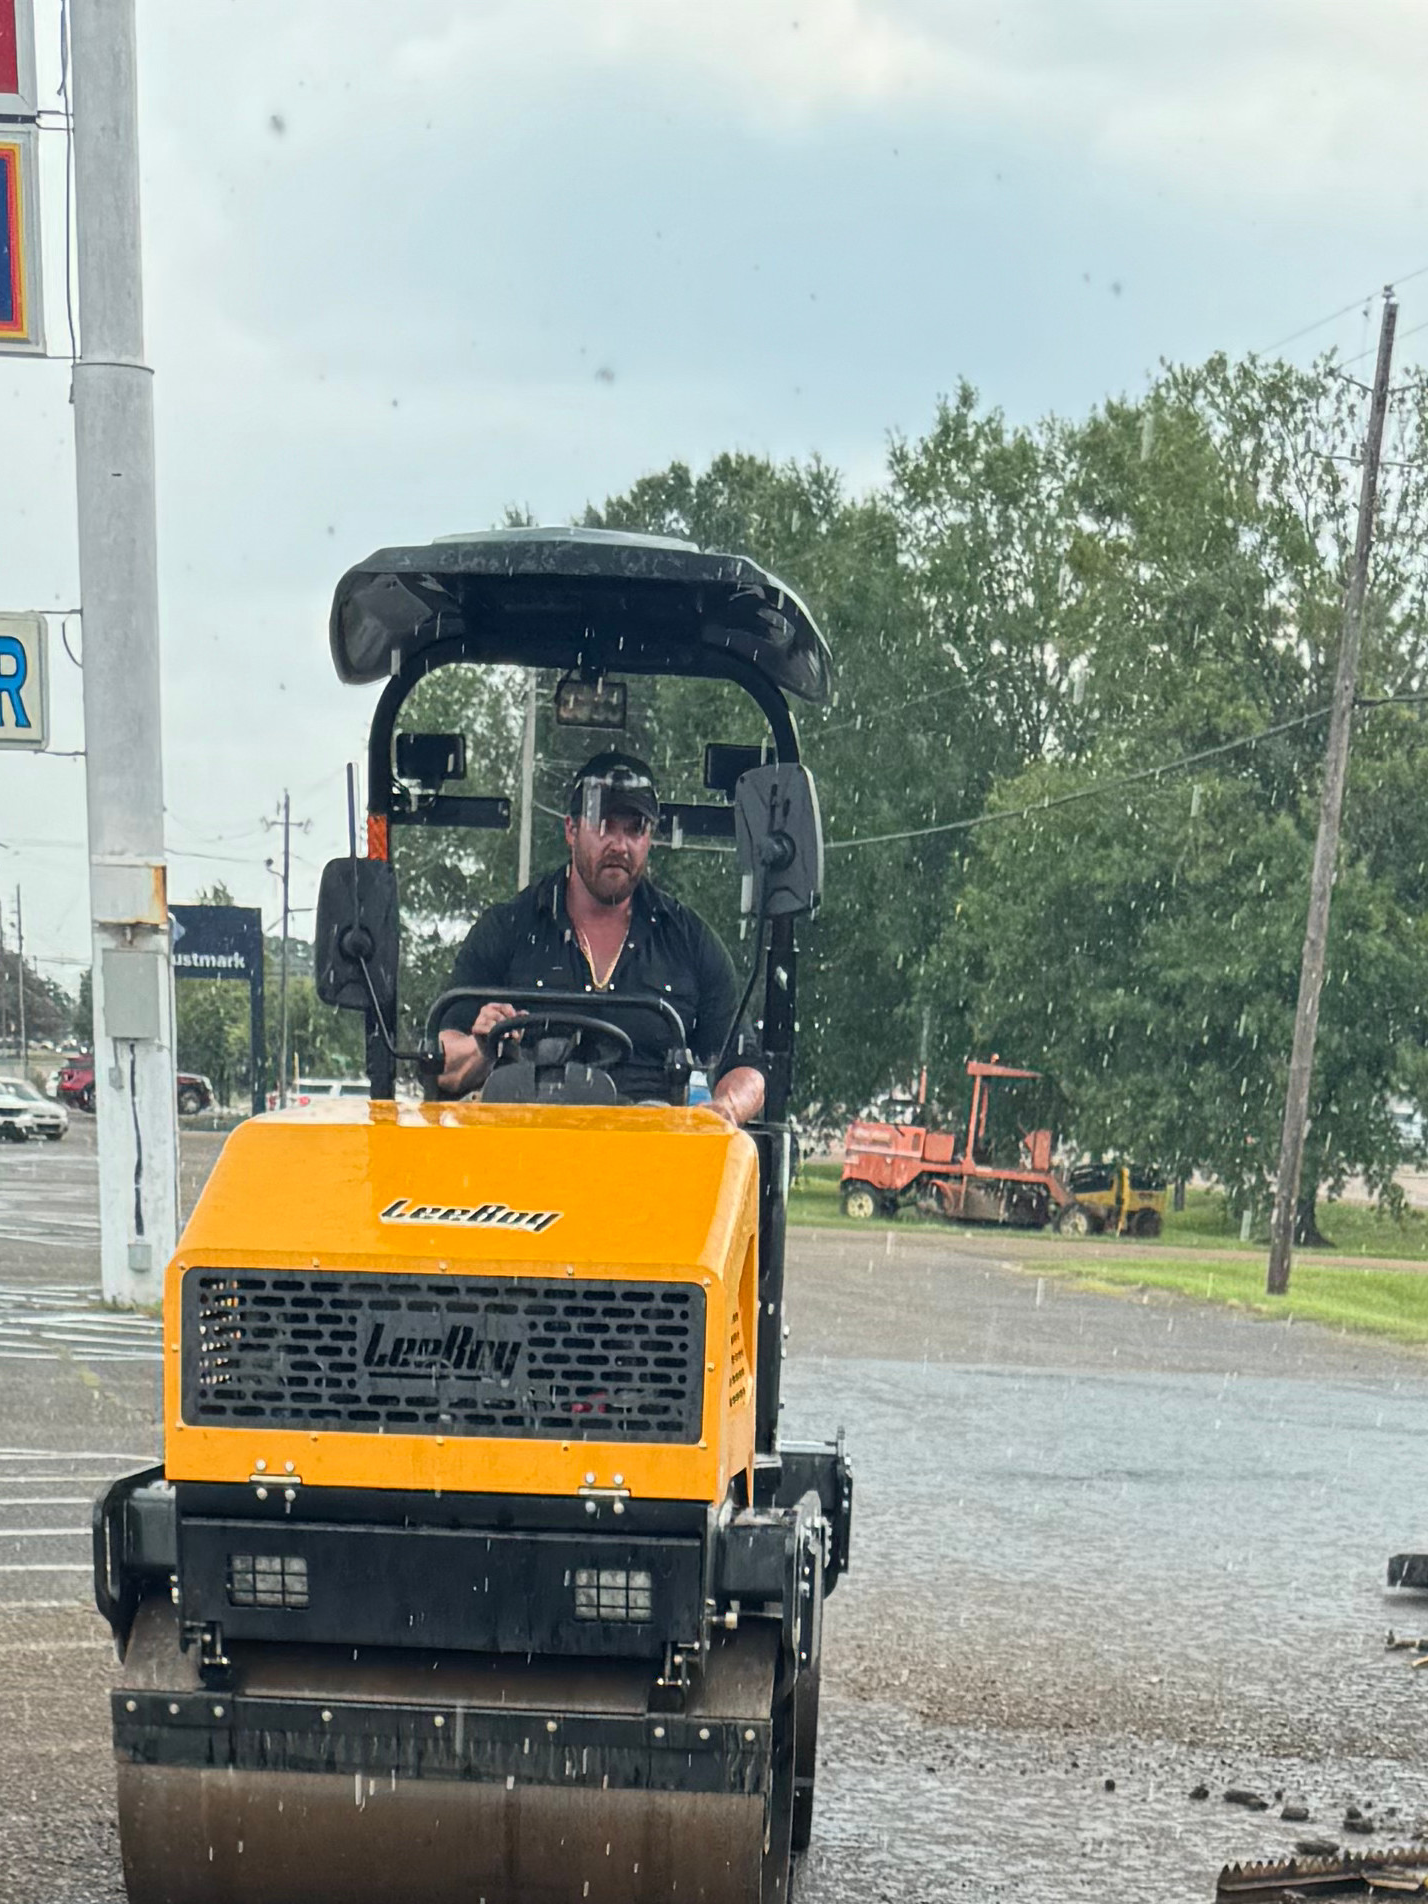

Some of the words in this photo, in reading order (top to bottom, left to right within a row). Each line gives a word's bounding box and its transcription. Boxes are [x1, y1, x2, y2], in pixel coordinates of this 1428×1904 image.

[171, 952, 246, 969] ustmark
[380, 1199, 561, 1232] LeeBoy
[363, 1323, 522, 1379] LeeBoy
